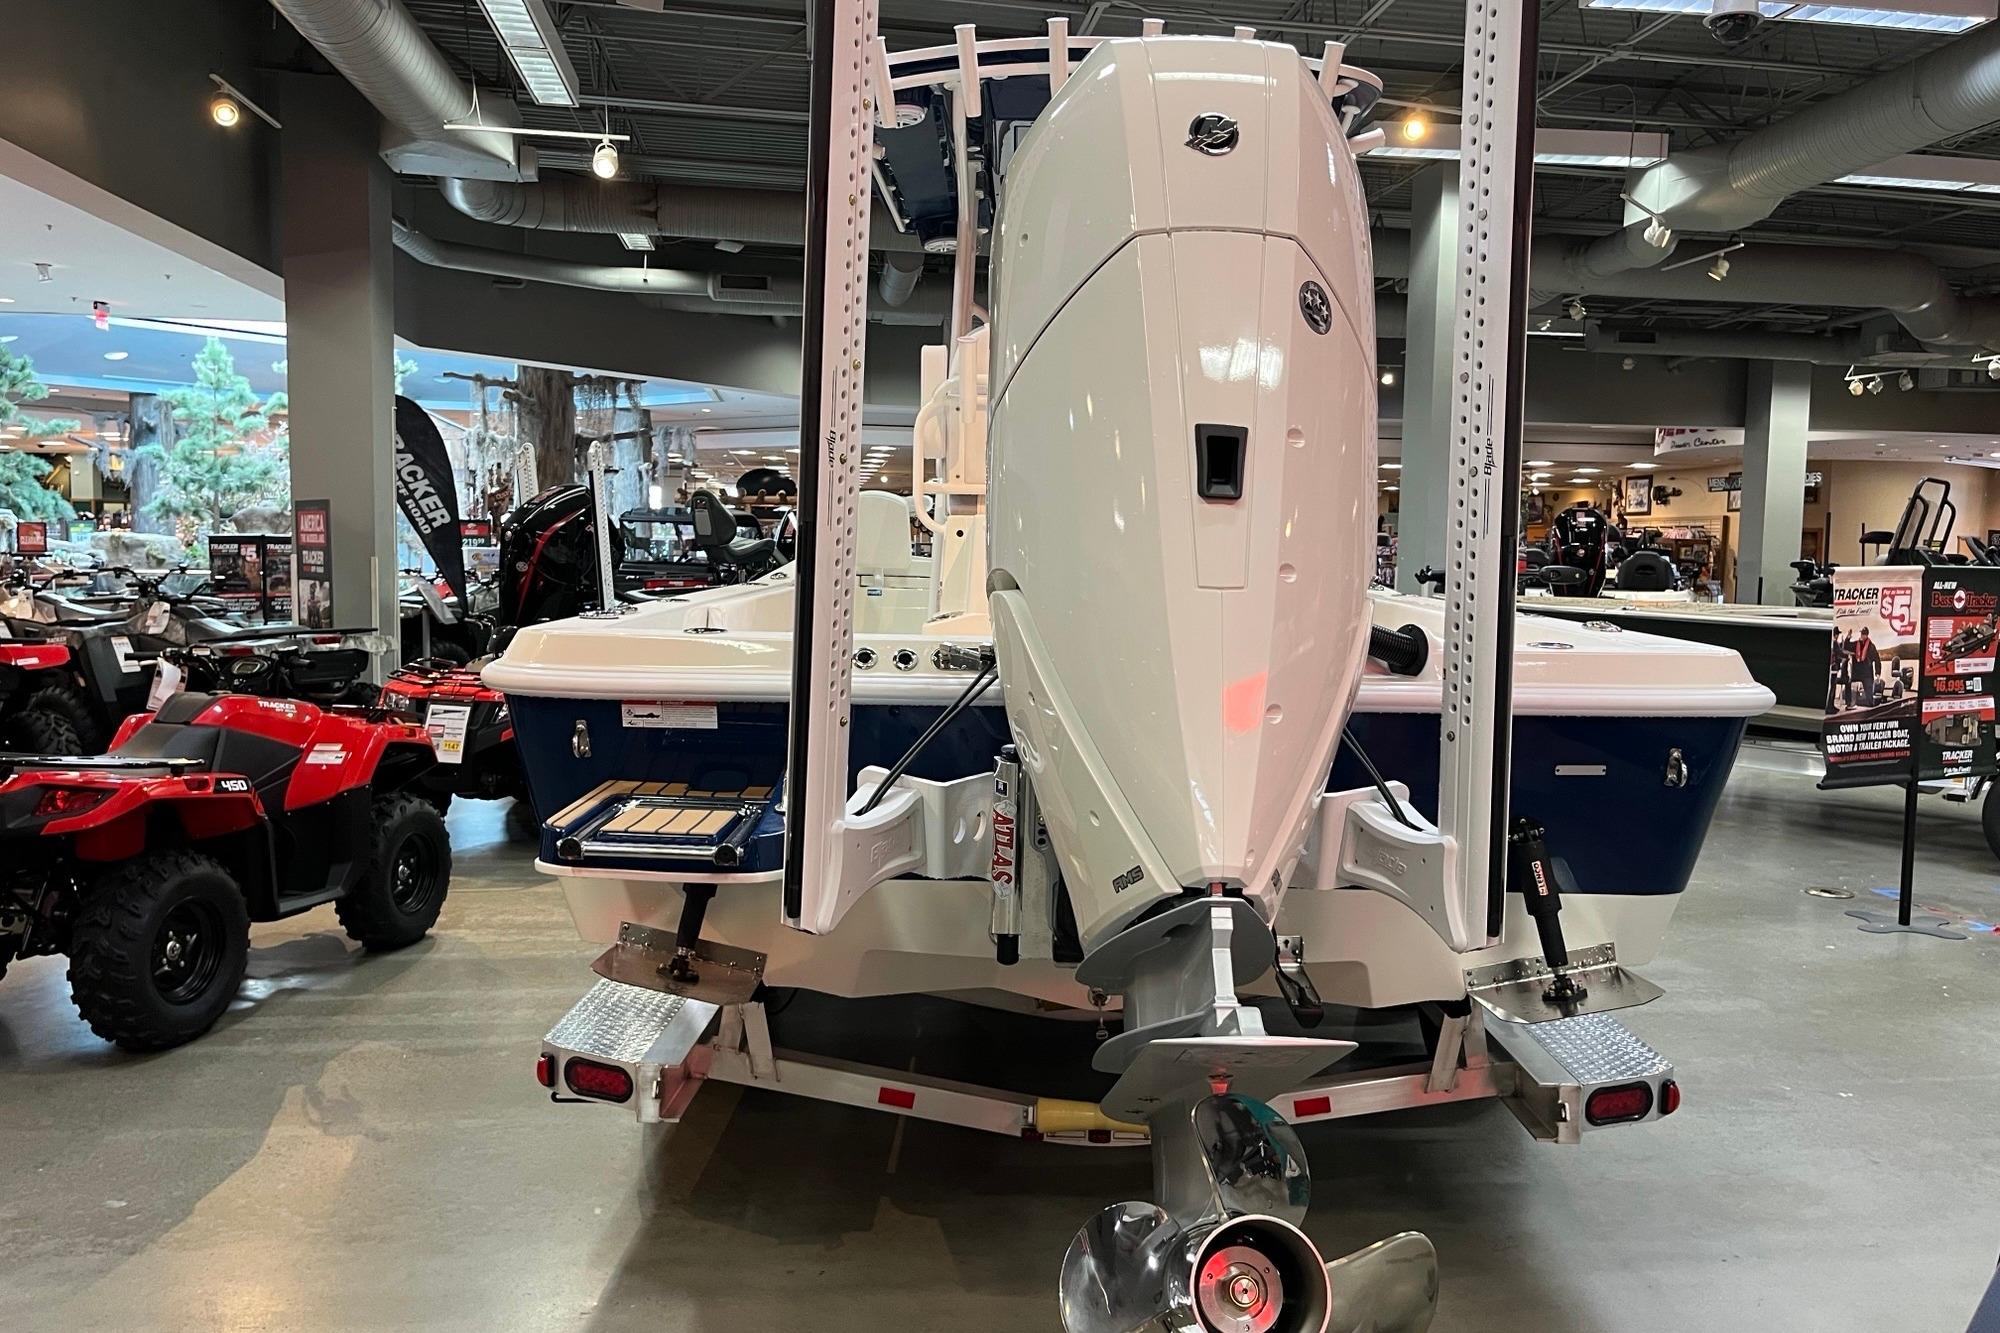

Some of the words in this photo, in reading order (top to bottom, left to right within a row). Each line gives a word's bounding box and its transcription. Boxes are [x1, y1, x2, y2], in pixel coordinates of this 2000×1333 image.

[1484, 438, 1498, 476] Blade
[396, 434, 451, 528] RACKER
[405, 499, 432, 534] ROAD
[1835, 587, 1879, 600] TRACKER
[1965, 591, 1998, 607] Tracker
[1881, 594, 1911, 632] $5
[258, 701, 296, 710] TRACKER
[1840, 724, 1859, 733] OWN
[1873, 721, 1886, 730] VERY
[1826, 734, 1855, 744] BRAND
[1868, 730, 1891, 740] TRACKER
[1826, 744, 1854, 754] MOTOR
[1858, 741, 1882, 751] TRAILER
[1882, 739, 1911, 749] PACKAGE.
[1942, 750, 1973, 761] TRACKER
[221, 780, 248, 792] 450
[992, 808, 1016, 885] ATLAS
